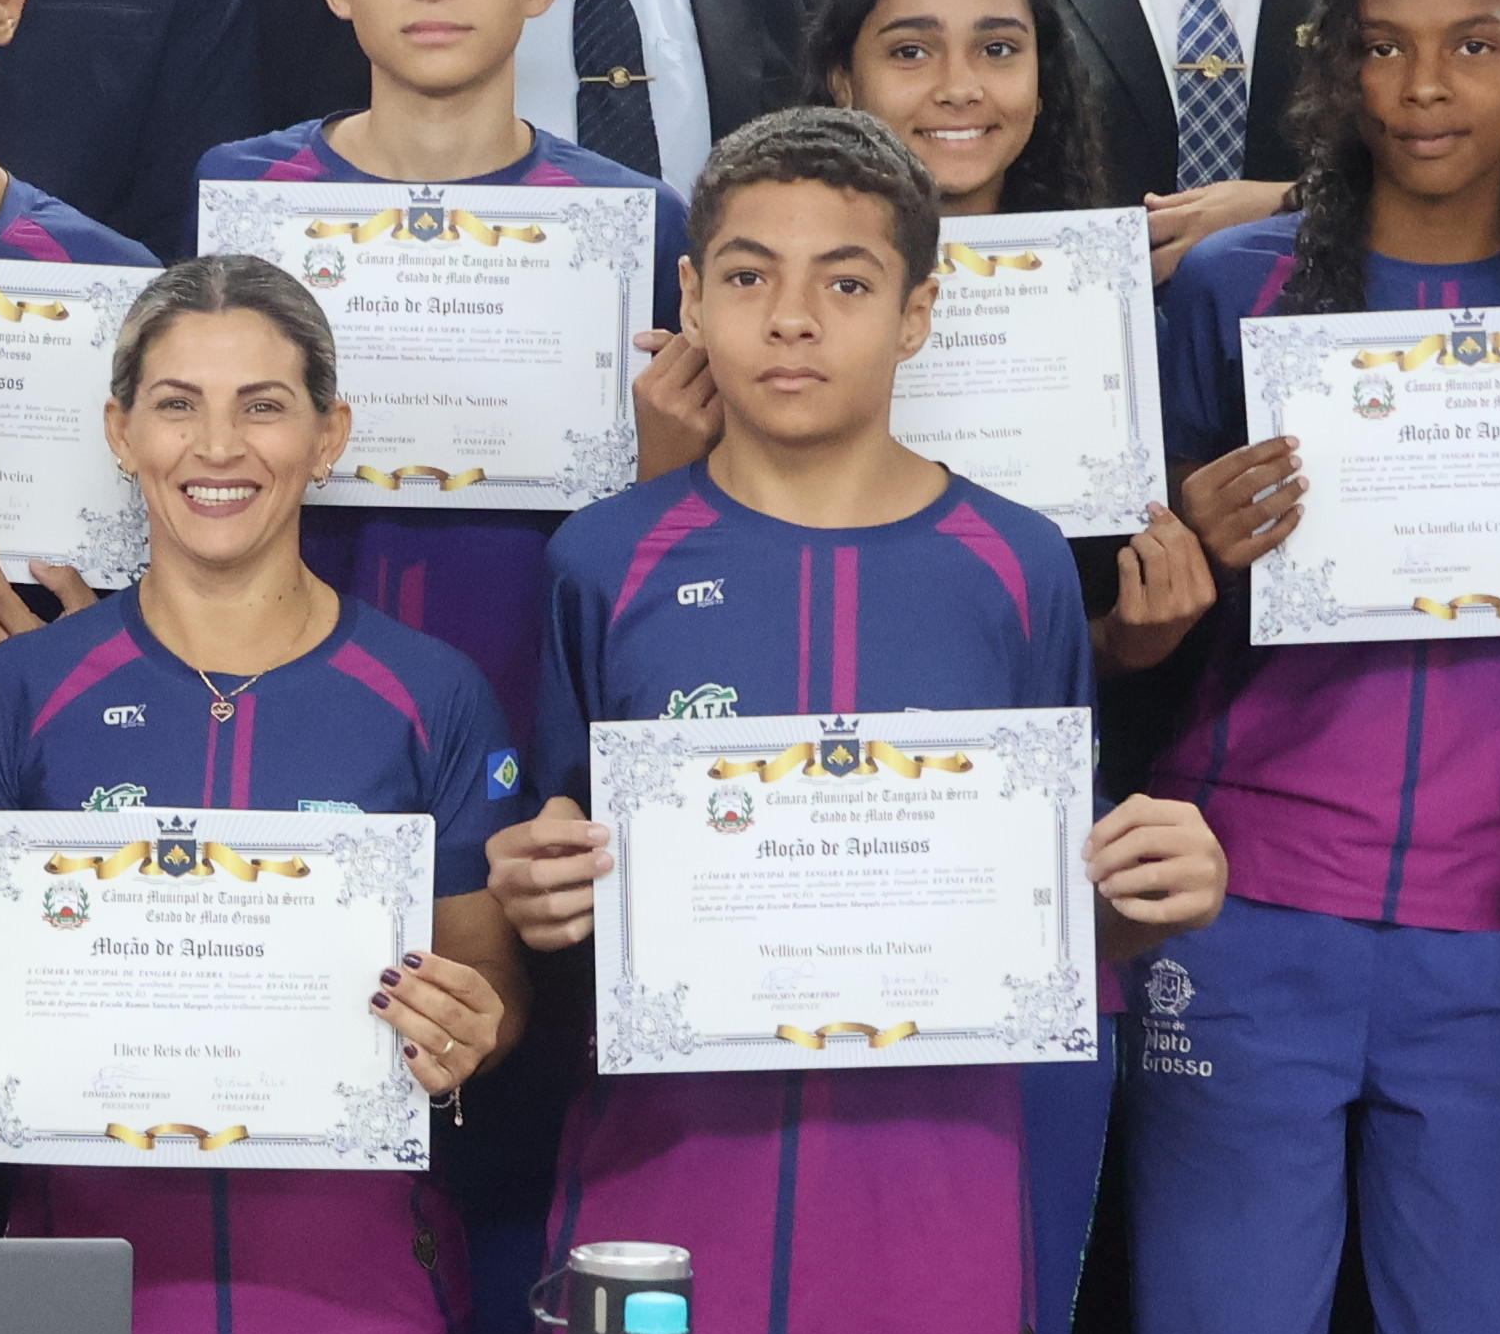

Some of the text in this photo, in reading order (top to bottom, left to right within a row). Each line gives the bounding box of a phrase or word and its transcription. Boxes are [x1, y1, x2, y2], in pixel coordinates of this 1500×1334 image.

[344, 295, 504, 317] Moção de Aplausos
[930, 329, 1008, 352] Aplausos
[1397, 422, 1451, 445] Moção
[1454, 423, 1472, 440] de
[677, 578, 725, 603] GTX
[103, 704, 147, 727] GTX
[755, 836, 931, 862] Moção de Aplausos
[89, 936, 265, 961] Moção de Aplausos
[1143, 1050, 1213, 1077] Grosso
